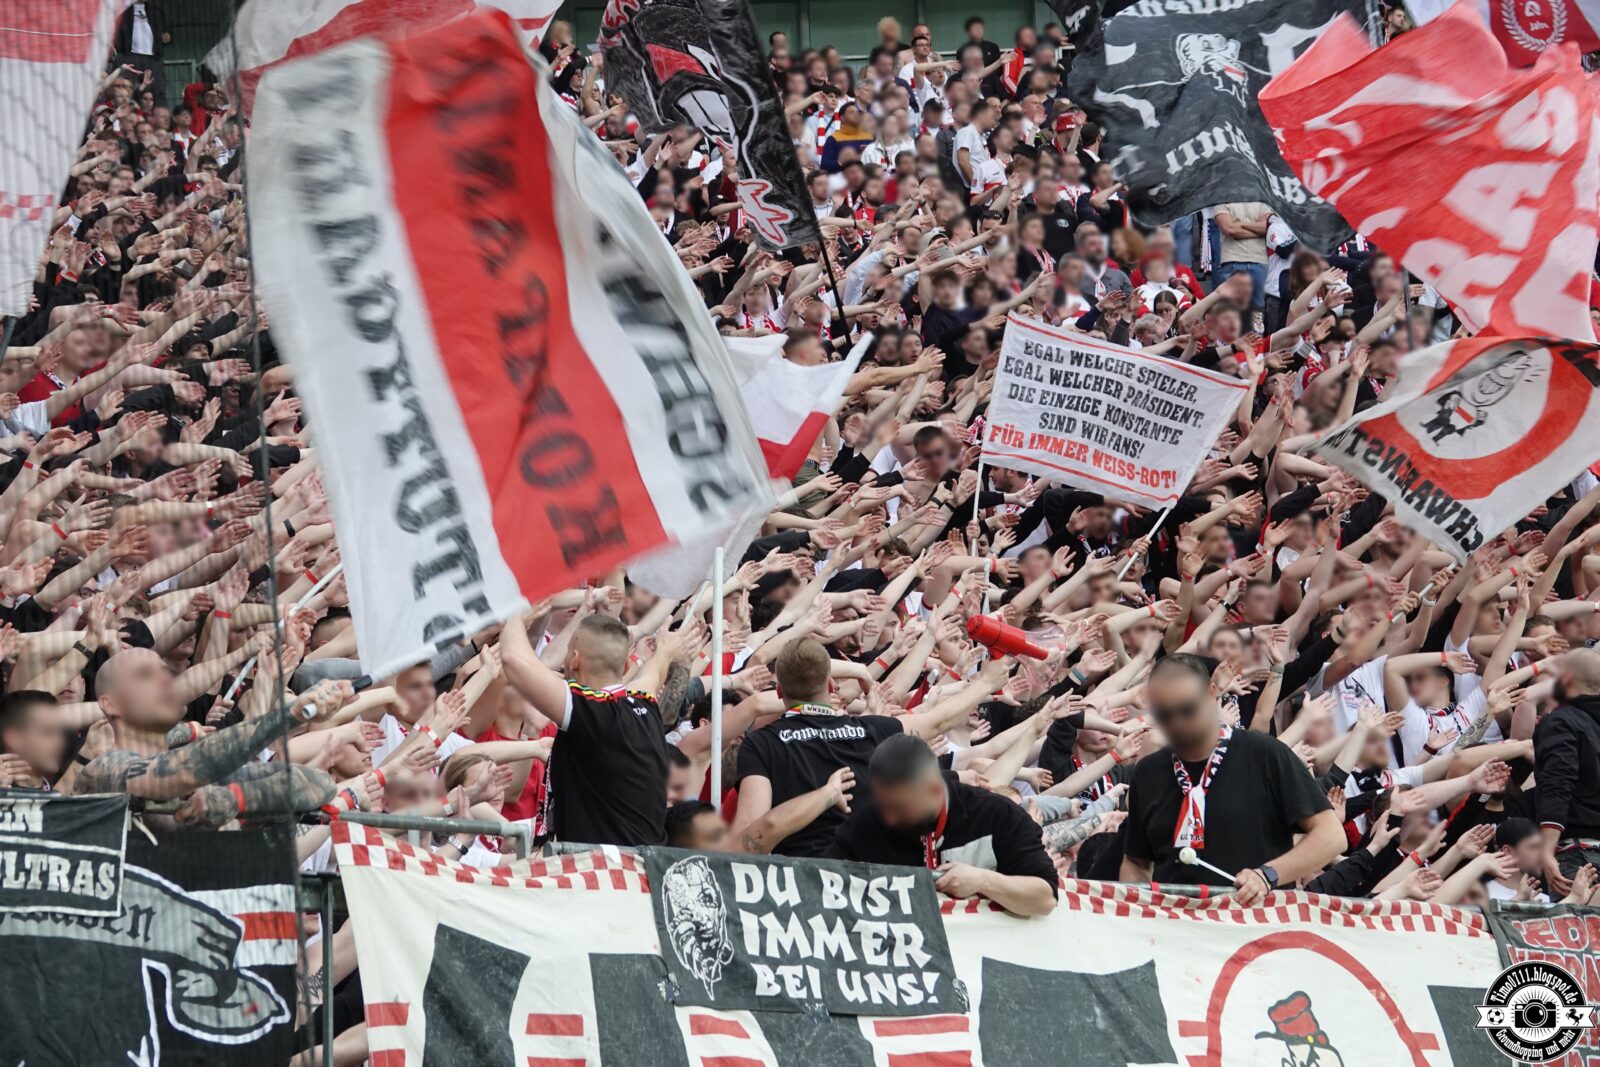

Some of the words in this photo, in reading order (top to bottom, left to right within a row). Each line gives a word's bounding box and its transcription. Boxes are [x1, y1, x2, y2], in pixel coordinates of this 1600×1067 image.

[1003, 355, 1043, 383] EGAL
[1049, 367, 1123, 400] WELCHER
[1024, 339, 1064, 364] EGAL
[1070, 350, 1135, 378] WELCHE
[1137, 366, 1198, 404] SPIELER,
[1007, 383, 1036, 403] DIE
[1039, 389, 1102, 416] EINZIGE
[1103, 403, 1183, 445] KONSTANTE
[1039, 412, 1077, 433] SIND
[1081, 420, 1109, 447] WIR
[1107, 431, 1145, 459] FANS!
[989, 423, 1025, 448] FÜR
[1028, 432, 1089, 463] IMMER
[1092, 448, 1177, 489] WEISS-ROT!
[0, 851, 115, 900] LTRAS
[731, 862, 801, 907] DU
[819, 869, 915, 917] BIST
[739, 908, 932, 969] IMMER
[751, 963, 822, 999] BEI
[837, 968, 940, 1005] UNS!
